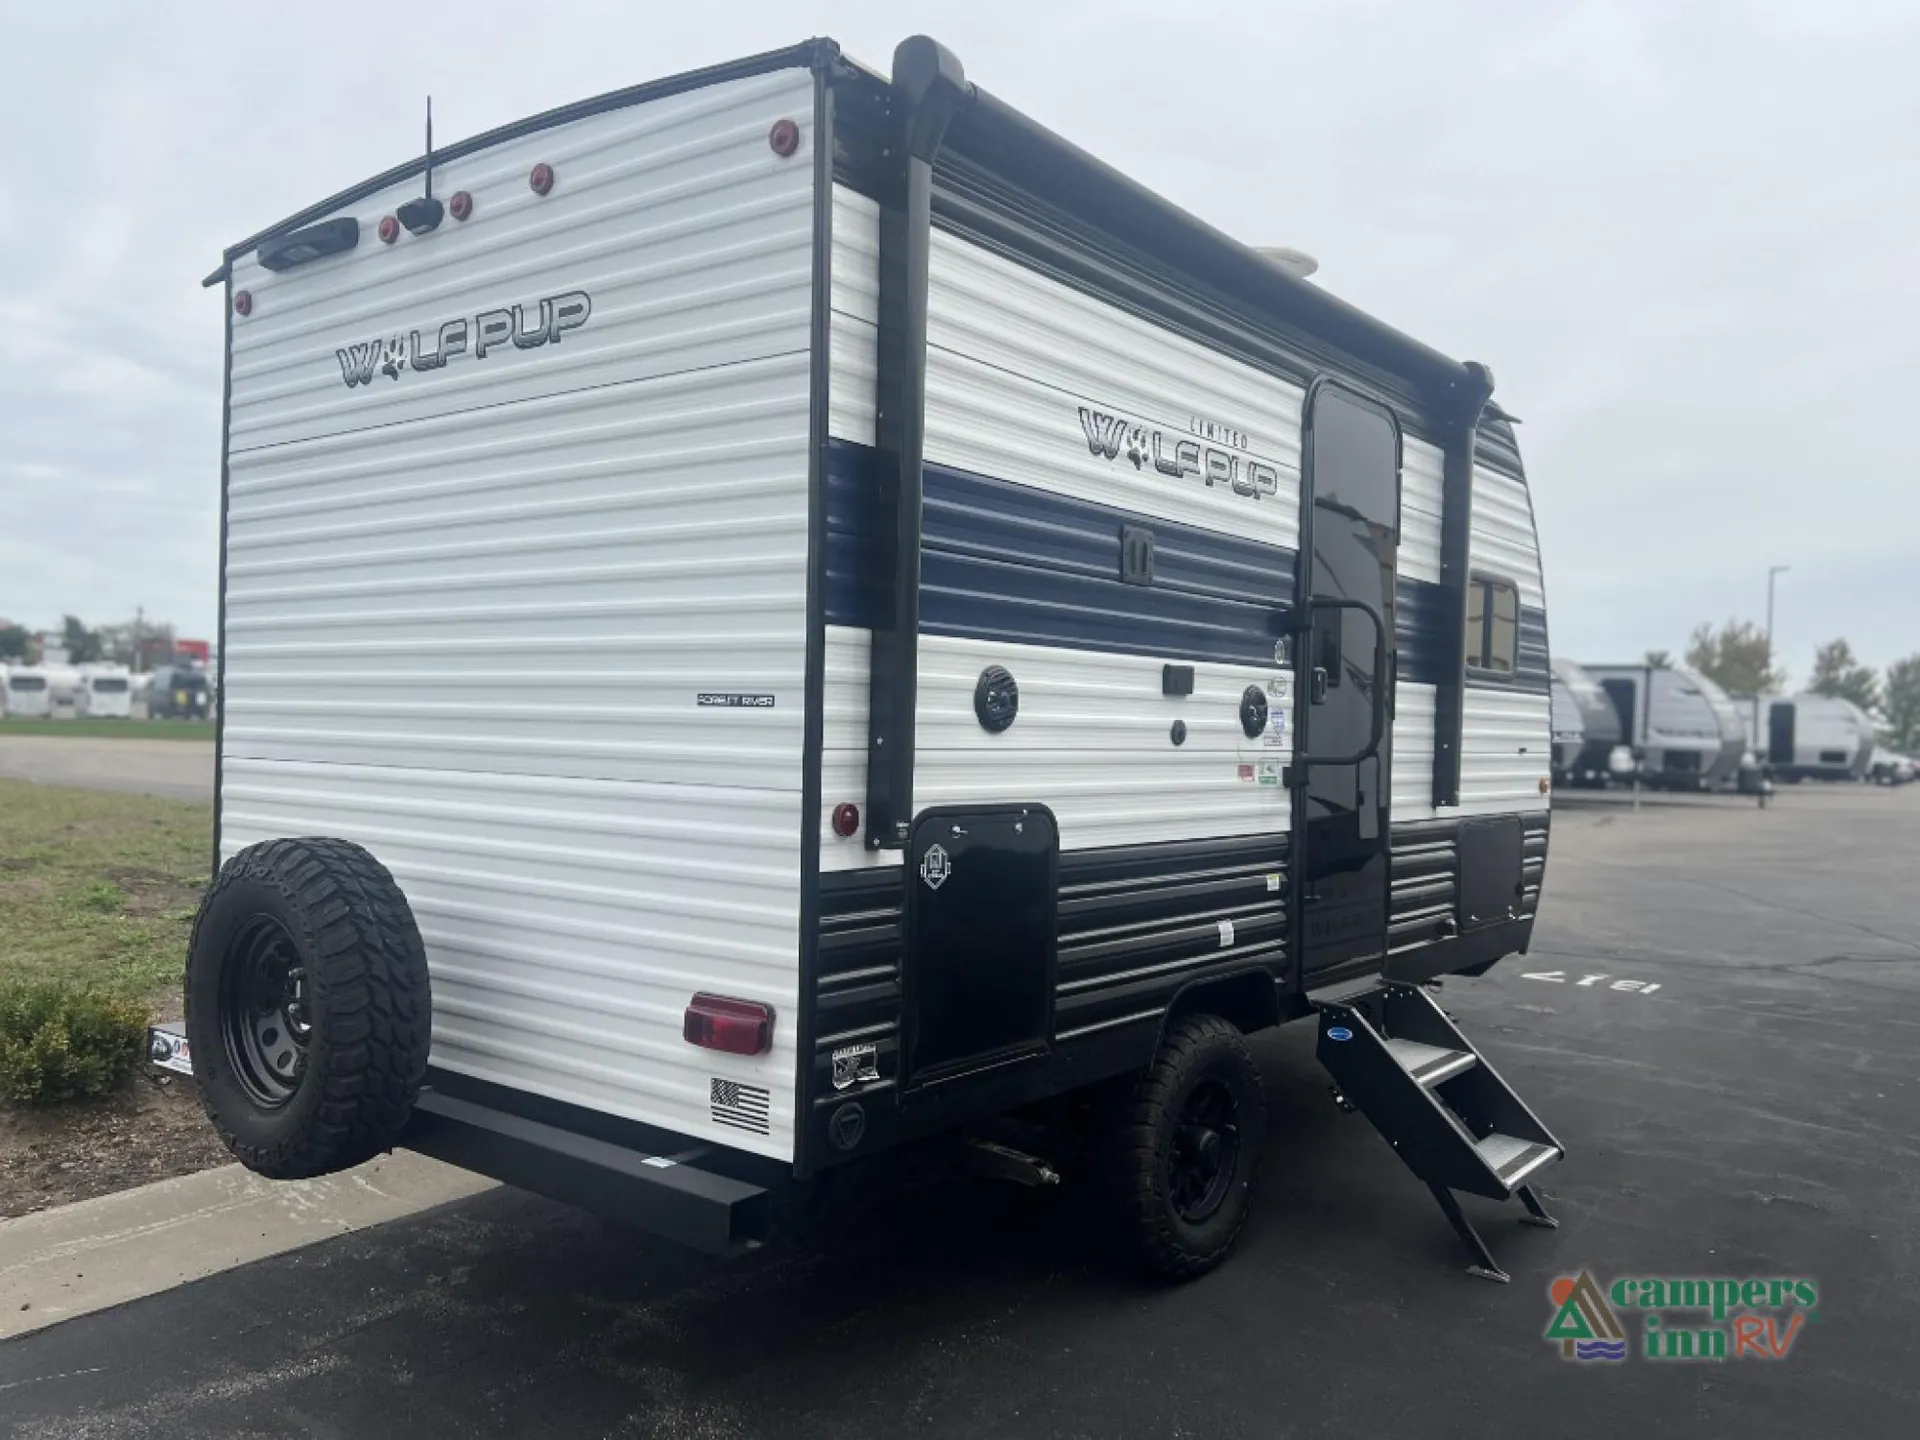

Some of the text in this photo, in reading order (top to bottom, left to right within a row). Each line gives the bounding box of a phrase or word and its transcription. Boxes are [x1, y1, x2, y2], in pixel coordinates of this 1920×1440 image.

[476, 290, 591, 359] PUP
[1190, 415, 1247, 448] LIMITED
[1206, 448, 1277, 500] PUP
